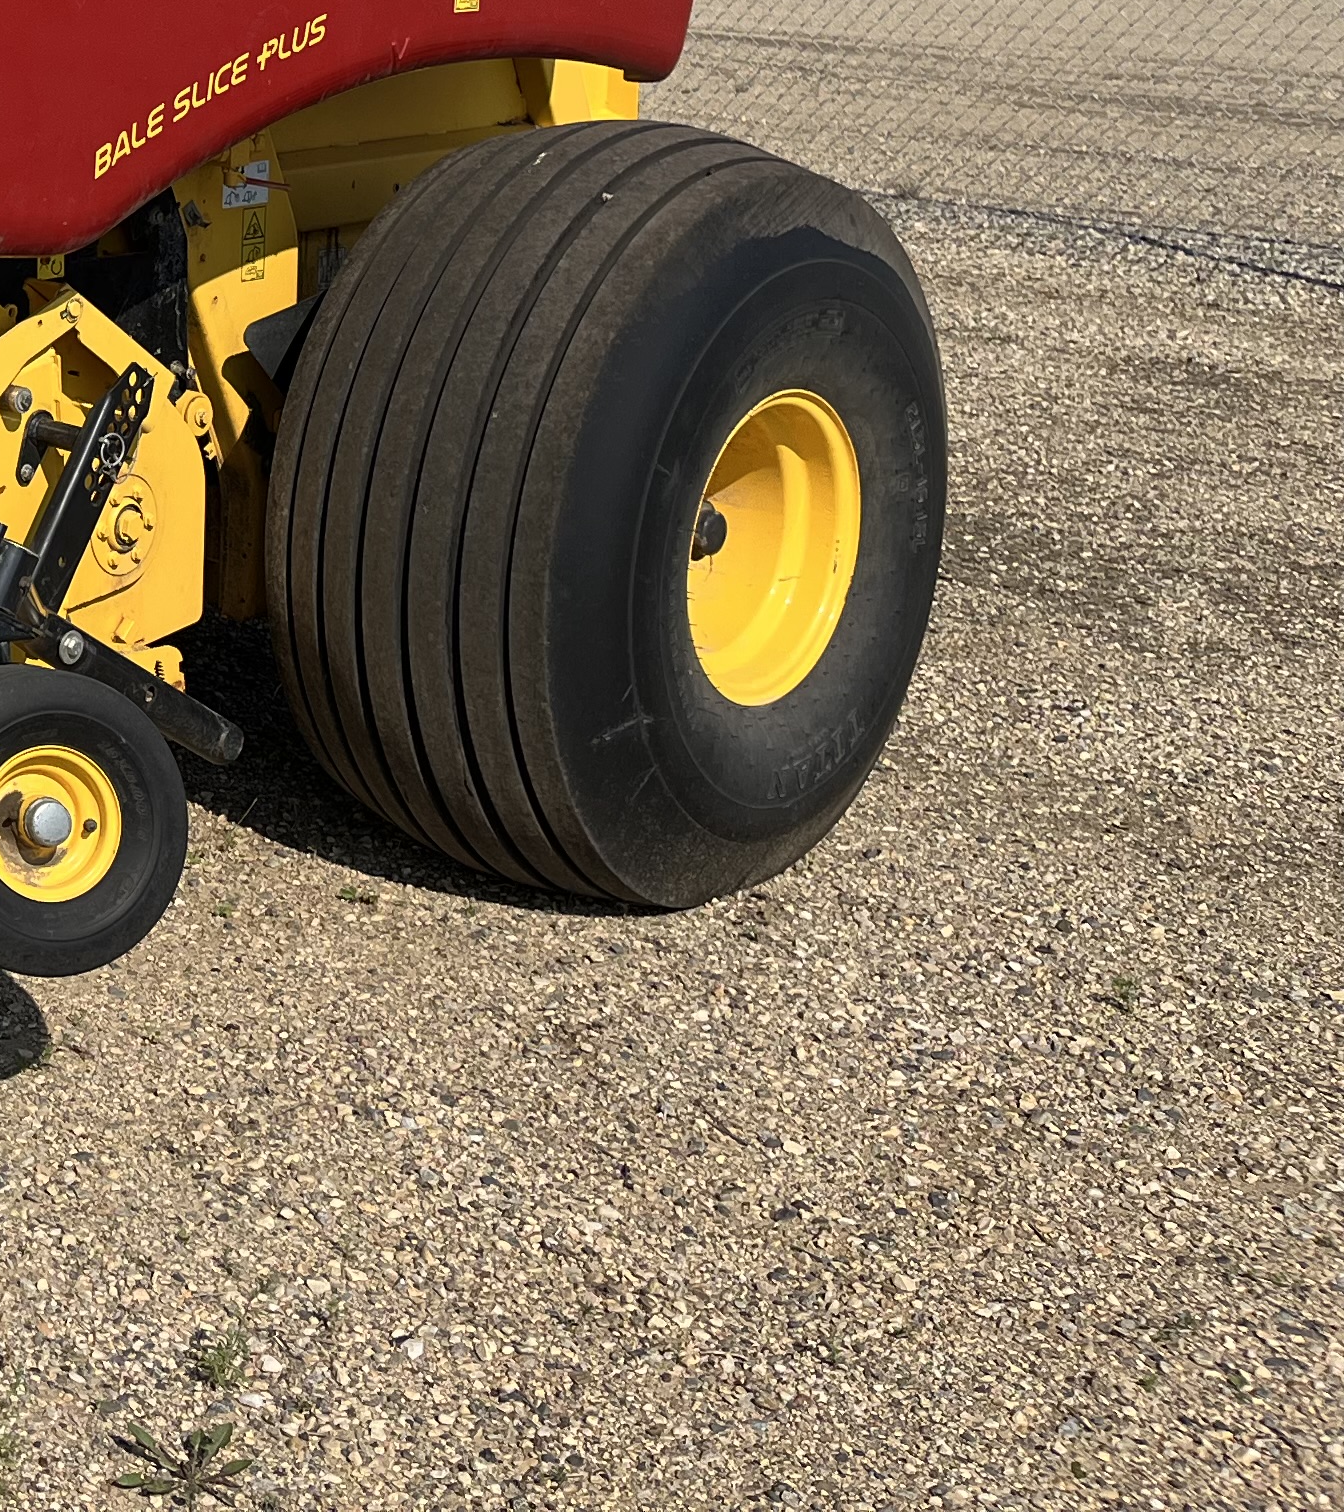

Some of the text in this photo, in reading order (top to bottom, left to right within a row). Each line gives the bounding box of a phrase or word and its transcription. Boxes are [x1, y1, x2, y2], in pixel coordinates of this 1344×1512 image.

[94, 13, 328, 180] BALE SLICE PLUS
